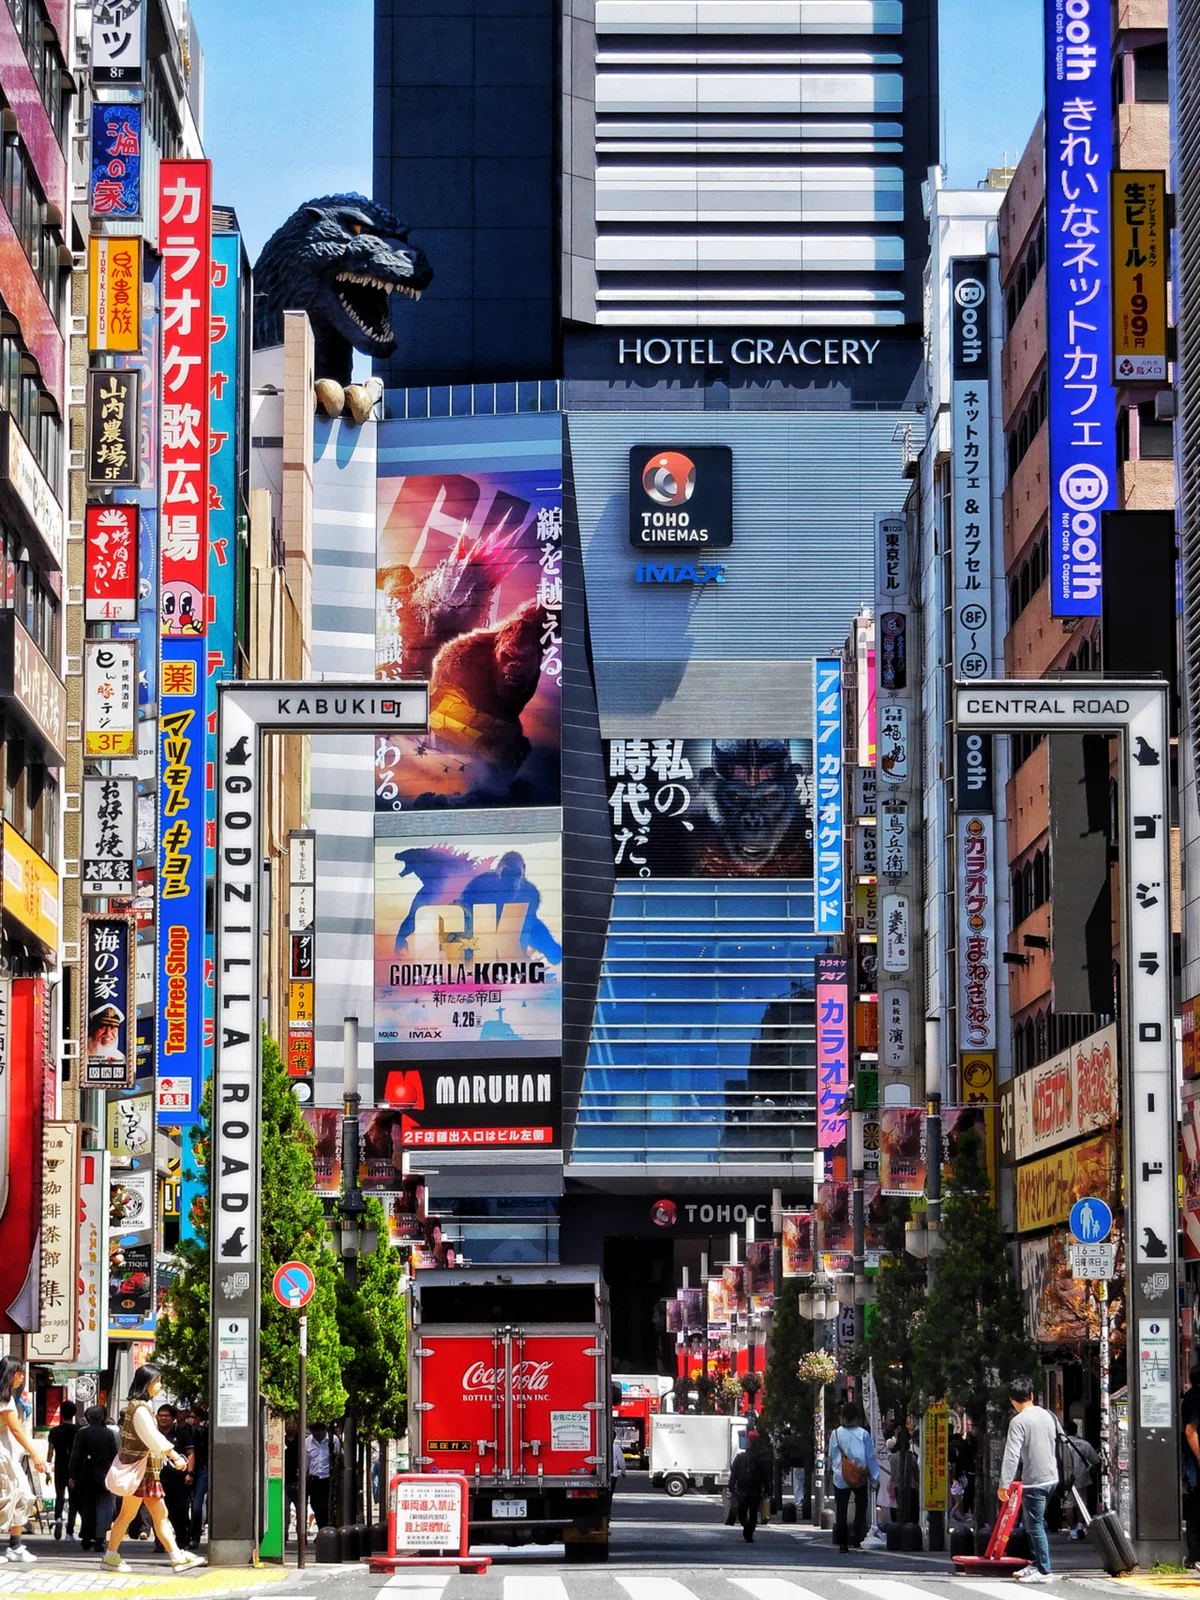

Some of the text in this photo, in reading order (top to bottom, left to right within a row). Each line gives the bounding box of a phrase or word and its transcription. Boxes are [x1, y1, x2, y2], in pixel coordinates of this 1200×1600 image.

[1065, 0, 1096, 80] ooth
[110, 67, 124, 78] 8F
[93, 122, 139, 214] 海の家
[1124, 183, 1146, 268] 生ビール
[1149, 184, 1157, 267] ザ・プレミアム・モルツ
[1060, 97, 1102, 446] きれいなネットカフェ
[955, 278, 985, 363] Booth
[1131, 272, 1149, 348] 199円
[618, 338, 881, 365] HOTEL GRACERY
[161, 177, 202, 562] カラオケ歌広場
[97, 377, 127, 467] 山内農場
[105, 468, 120, 479] 5F
[964, 391, 981, 590] ネットカフェ & カプセル
[641, 513, 689, 527] TOHO
[641, 529, 709, 541] CINEMAS
[1059, 463, 1108, 599] Booth
[111, 526, 133, 579] 焼肉屋
[886, 534, 900, 590] 東京ビル
[635, 563, 726, 583] IMAX
[99, 601, 122, 619] 4F
[966, 611, 982, 623] 8F
[164, 664, 192, 692] 薬
[966, 660, 982, 671] 5F
[121, 659, 130, 709] 豚・焼肉酒房
[375, 596, 402, 811] 常識がわる。
[967, 700, 1130, 713] CENTRAL ROAD
[98, 734, 123, 750] 3F
[966, 735, 987, 790] ooth
[651, 739, 694, 831] 私の、
[96, 780, 124, 857] お好み焼
[162, 711, 195, 899] マツモトキヨシ
[608, 739, 652, 878] 時代だ。
[85, 862, 131, 881] 大阪家
[300, 936, 311, 968] ダーツ
[965, 837, 989, 1047] カラオケ まねきねこ
[94, 927, 120, 999] 海の家
[819, 959, 847, 967] カラオケ
[820, 972, 845, 980] 747
[222, 776, 252, 1212] GODZILLA ROAD
[432, 990, 503, 1007] 新たなる帝国
[1133, 814, 1162, 1182] ゴジラロード
[453, 1011, 475, 1028] 4.26
[409, 1031, 442, 1039] IMAX
[290, 1038, 310, 1070] 麻雀
[820, 998, 846, 1115] カラオケ
[89, 1067, 124, 1079] 居酒屋
[161, 1094, 187, 1106] 免税
[436, 1074, 551, 1104] MARUHAN
[138, 1102, 150, 1111] 2F
[404, 1129, 545, 1143] 2F店舗出入口はビル左側
[820, 1119, 847, 1133] 747
[1000, 1091, 1013, 1155] 3F
[685, 1205, 747, 1223] TOHO
[43, 1181, 65, 1308] 珈琲茶館集
[44, 1335, 58, 1343] 2F
[552, 1413, 588, 1421] お先にどうぞ
[428, 1442, 470, 1450] 高圧ガス
[401, 1500, 457, 1511] 車両進入禁止
[405, 1522, 452, 1532] 路上喫煙禁止
